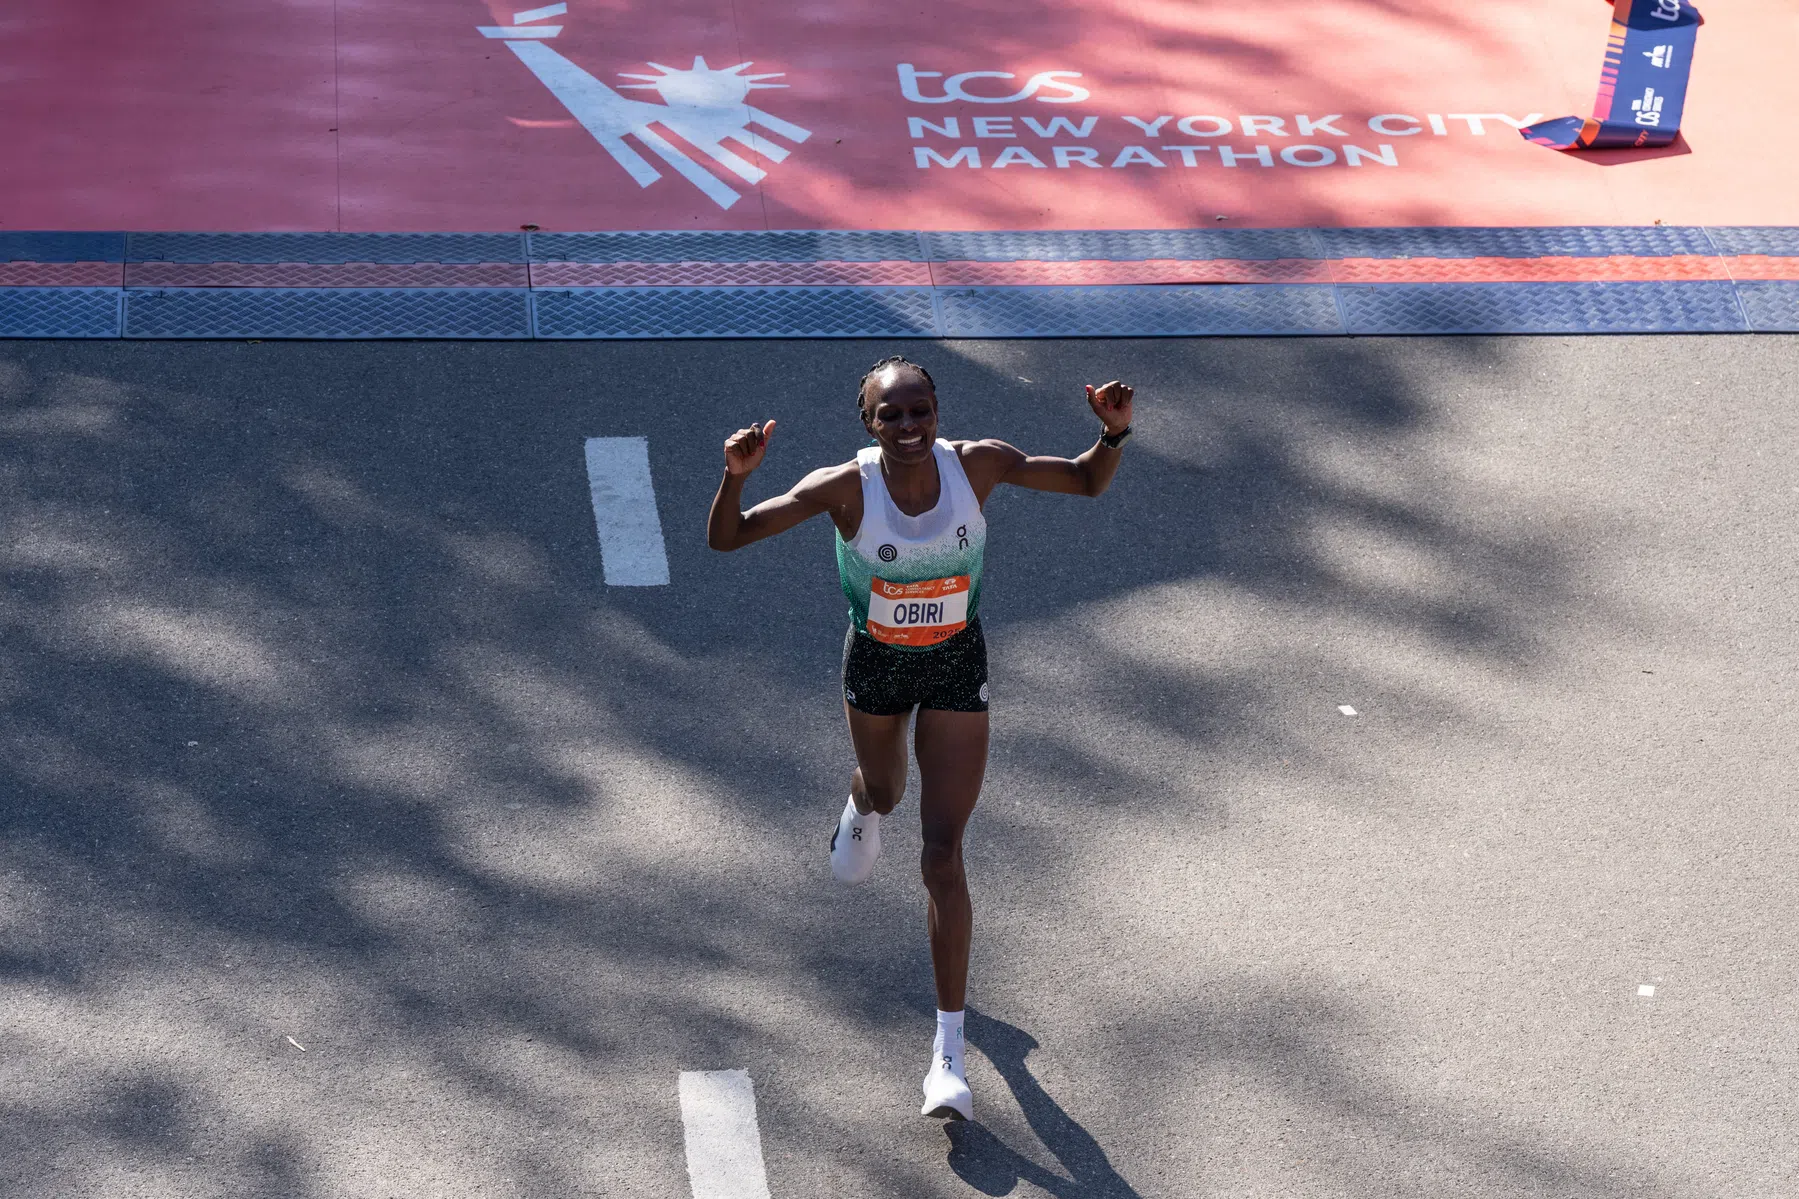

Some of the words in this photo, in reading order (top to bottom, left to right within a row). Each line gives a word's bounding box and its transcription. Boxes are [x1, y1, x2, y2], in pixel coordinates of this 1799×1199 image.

[897, 63, 1090, 103] tcs
[908, 116, 1098, 138] NEW
[1122, 114, 1351, 137] YORK
[1367, 112, 1544, 136] CITY
[914, 144, 1399, 169] MARATHON
[893, 602, 944, 625] OBIRI
